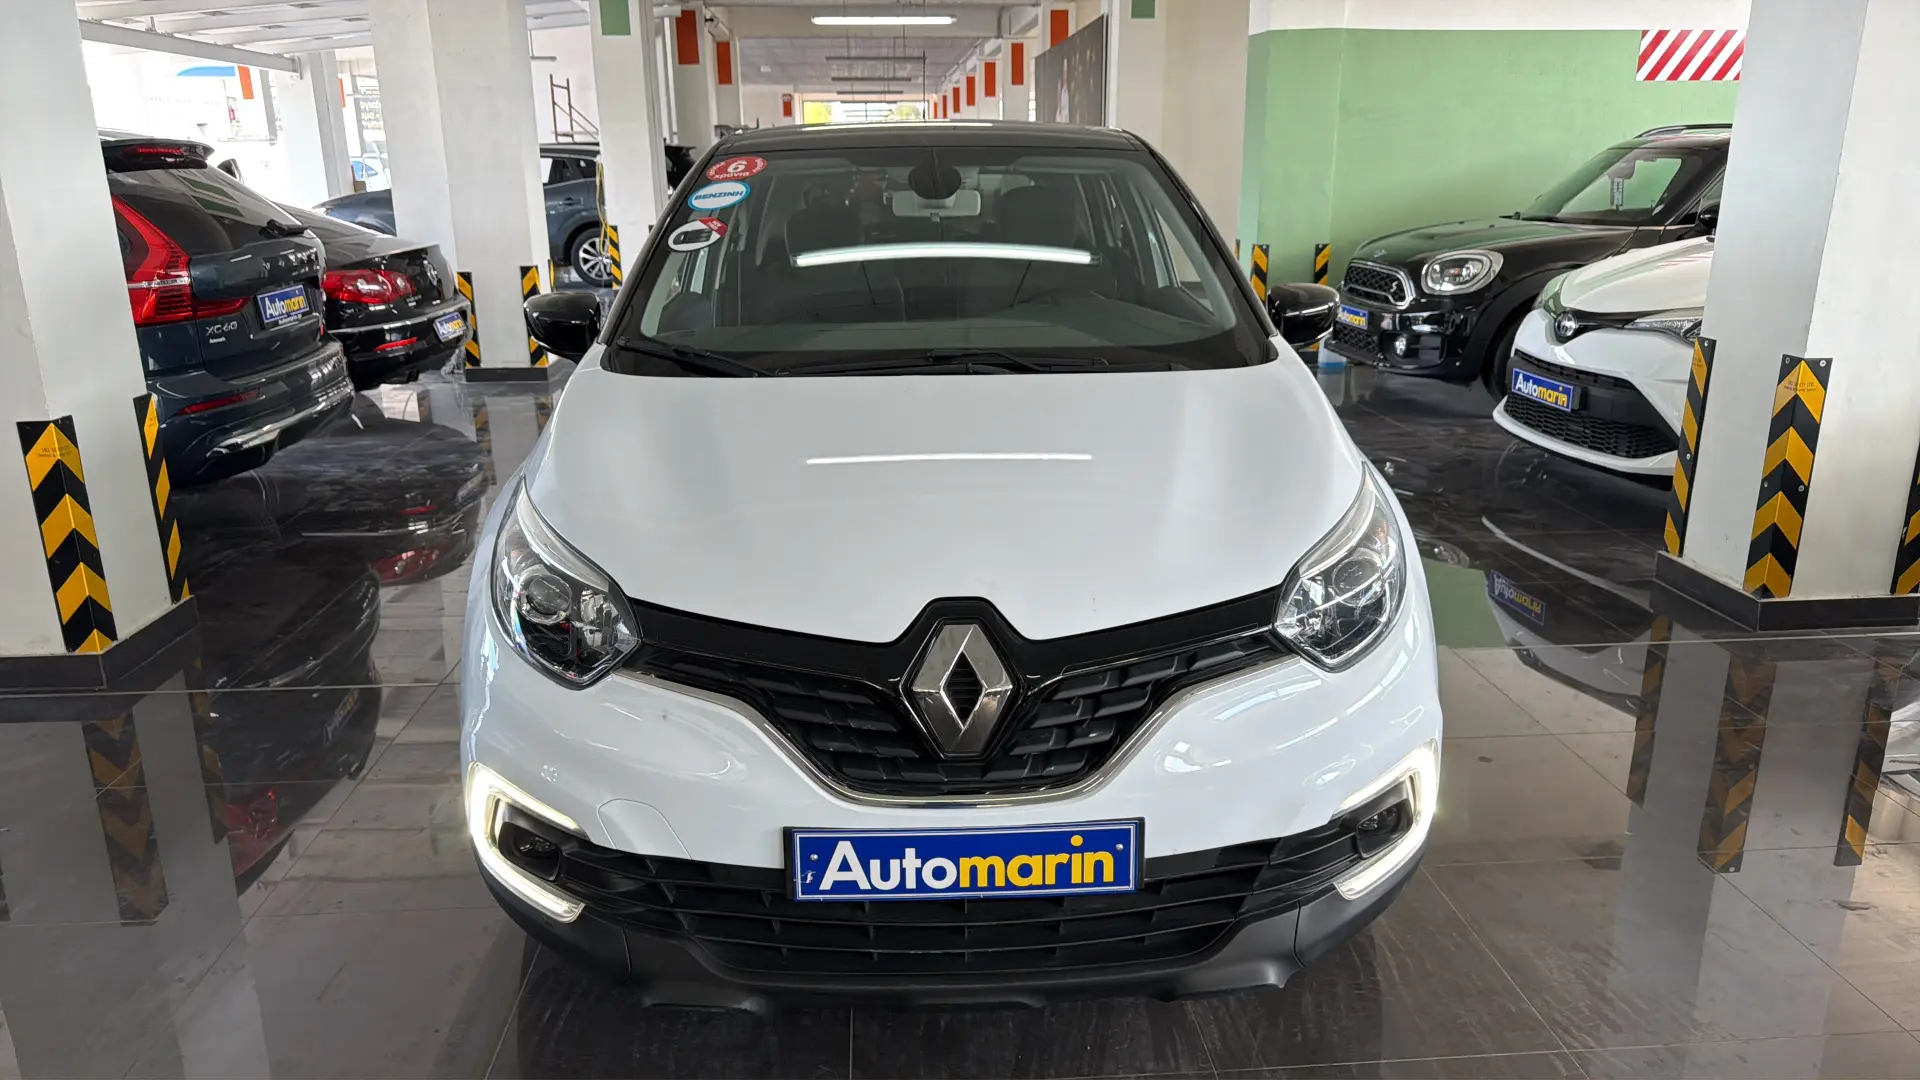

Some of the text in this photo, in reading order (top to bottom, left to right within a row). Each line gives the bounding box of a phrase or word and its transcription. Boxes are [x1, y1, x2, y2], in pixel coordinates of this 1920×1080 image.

[727, 161, 747, 172] 6
[265, 290, 306, 318] Automarin
[205, 321, 238, 336] XC60
[1515, 372, 1568, 407] Automarin
[819, 834, 1114, 890] Automarin
